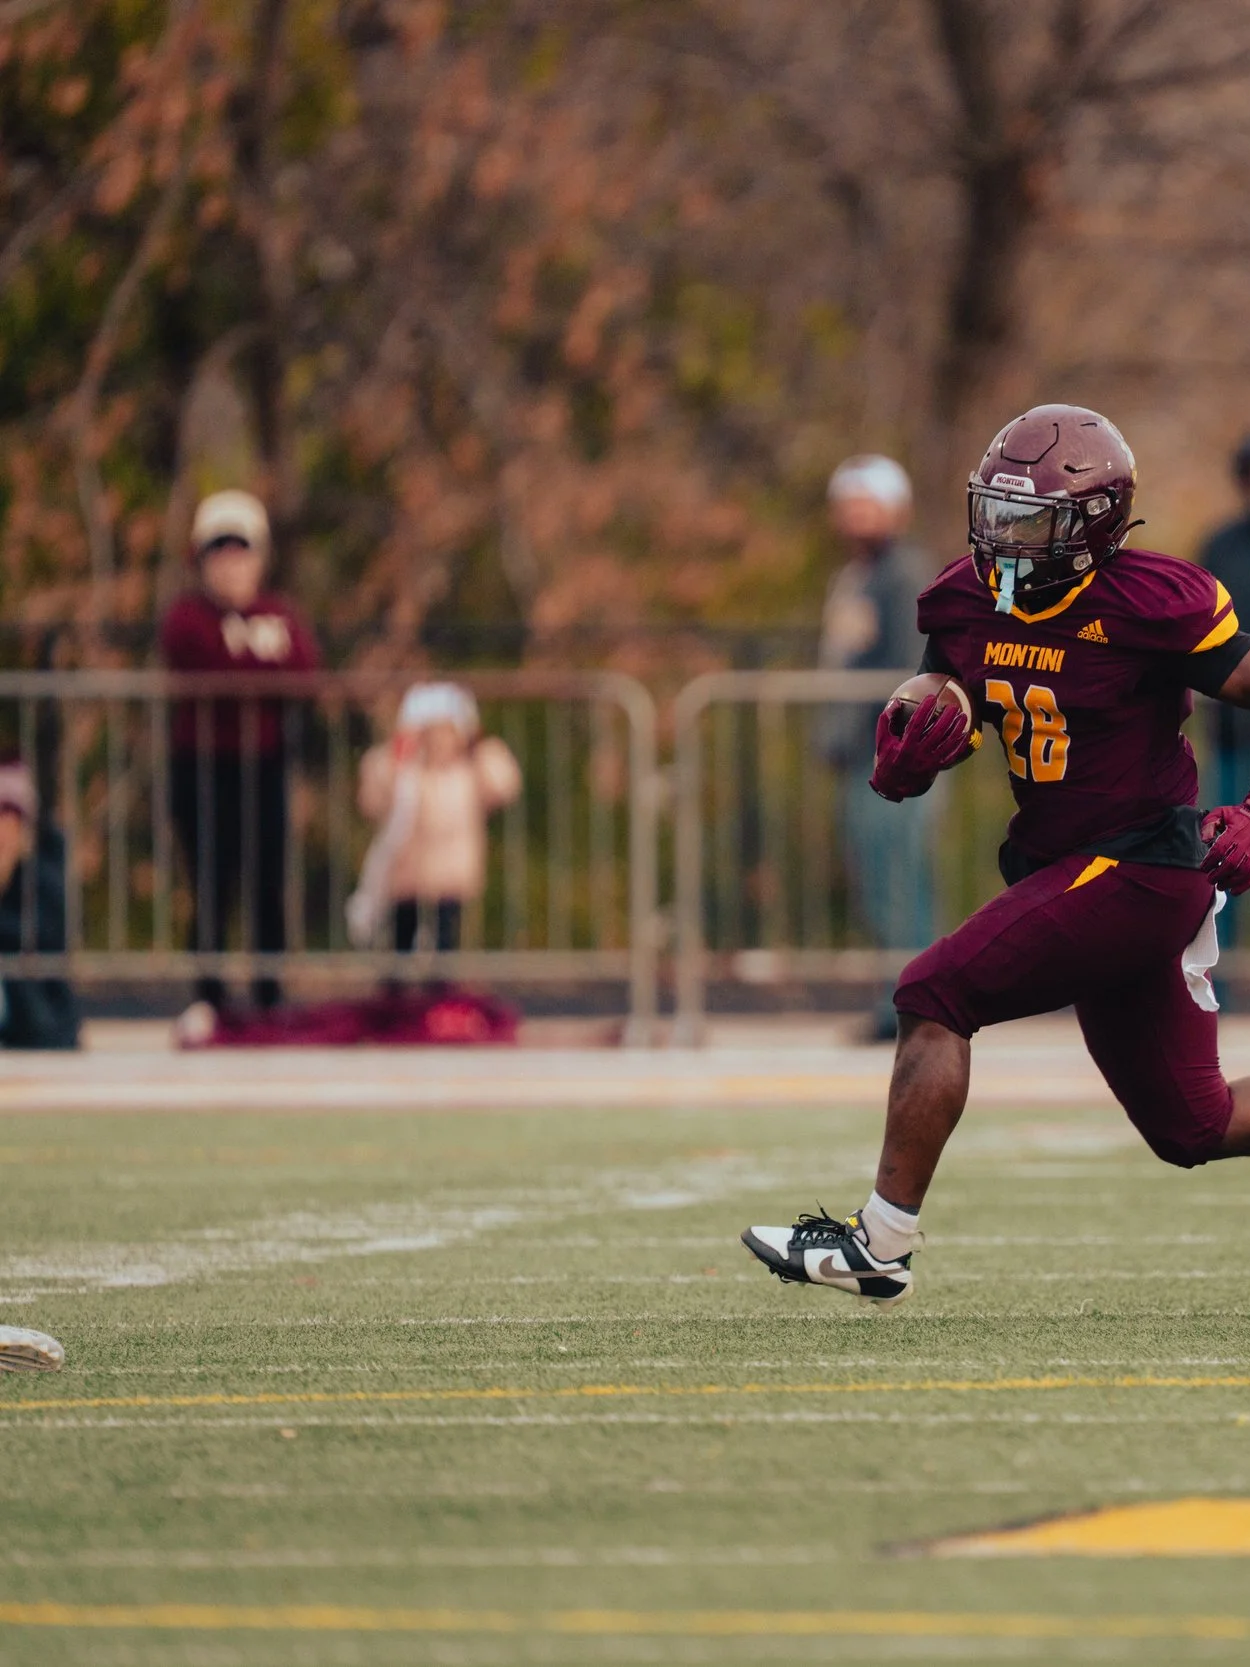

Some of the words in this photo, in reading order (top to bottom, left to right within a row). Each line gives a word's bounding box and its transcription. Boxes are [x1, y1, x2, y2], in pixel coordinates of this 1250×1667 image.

[996, 476, 1025, 487] MONTINI
[1077, 631, 1109, 644] adidas
[984, 641, 1066, 673] MONTINI
[985, 679, 1071, 783] 28
